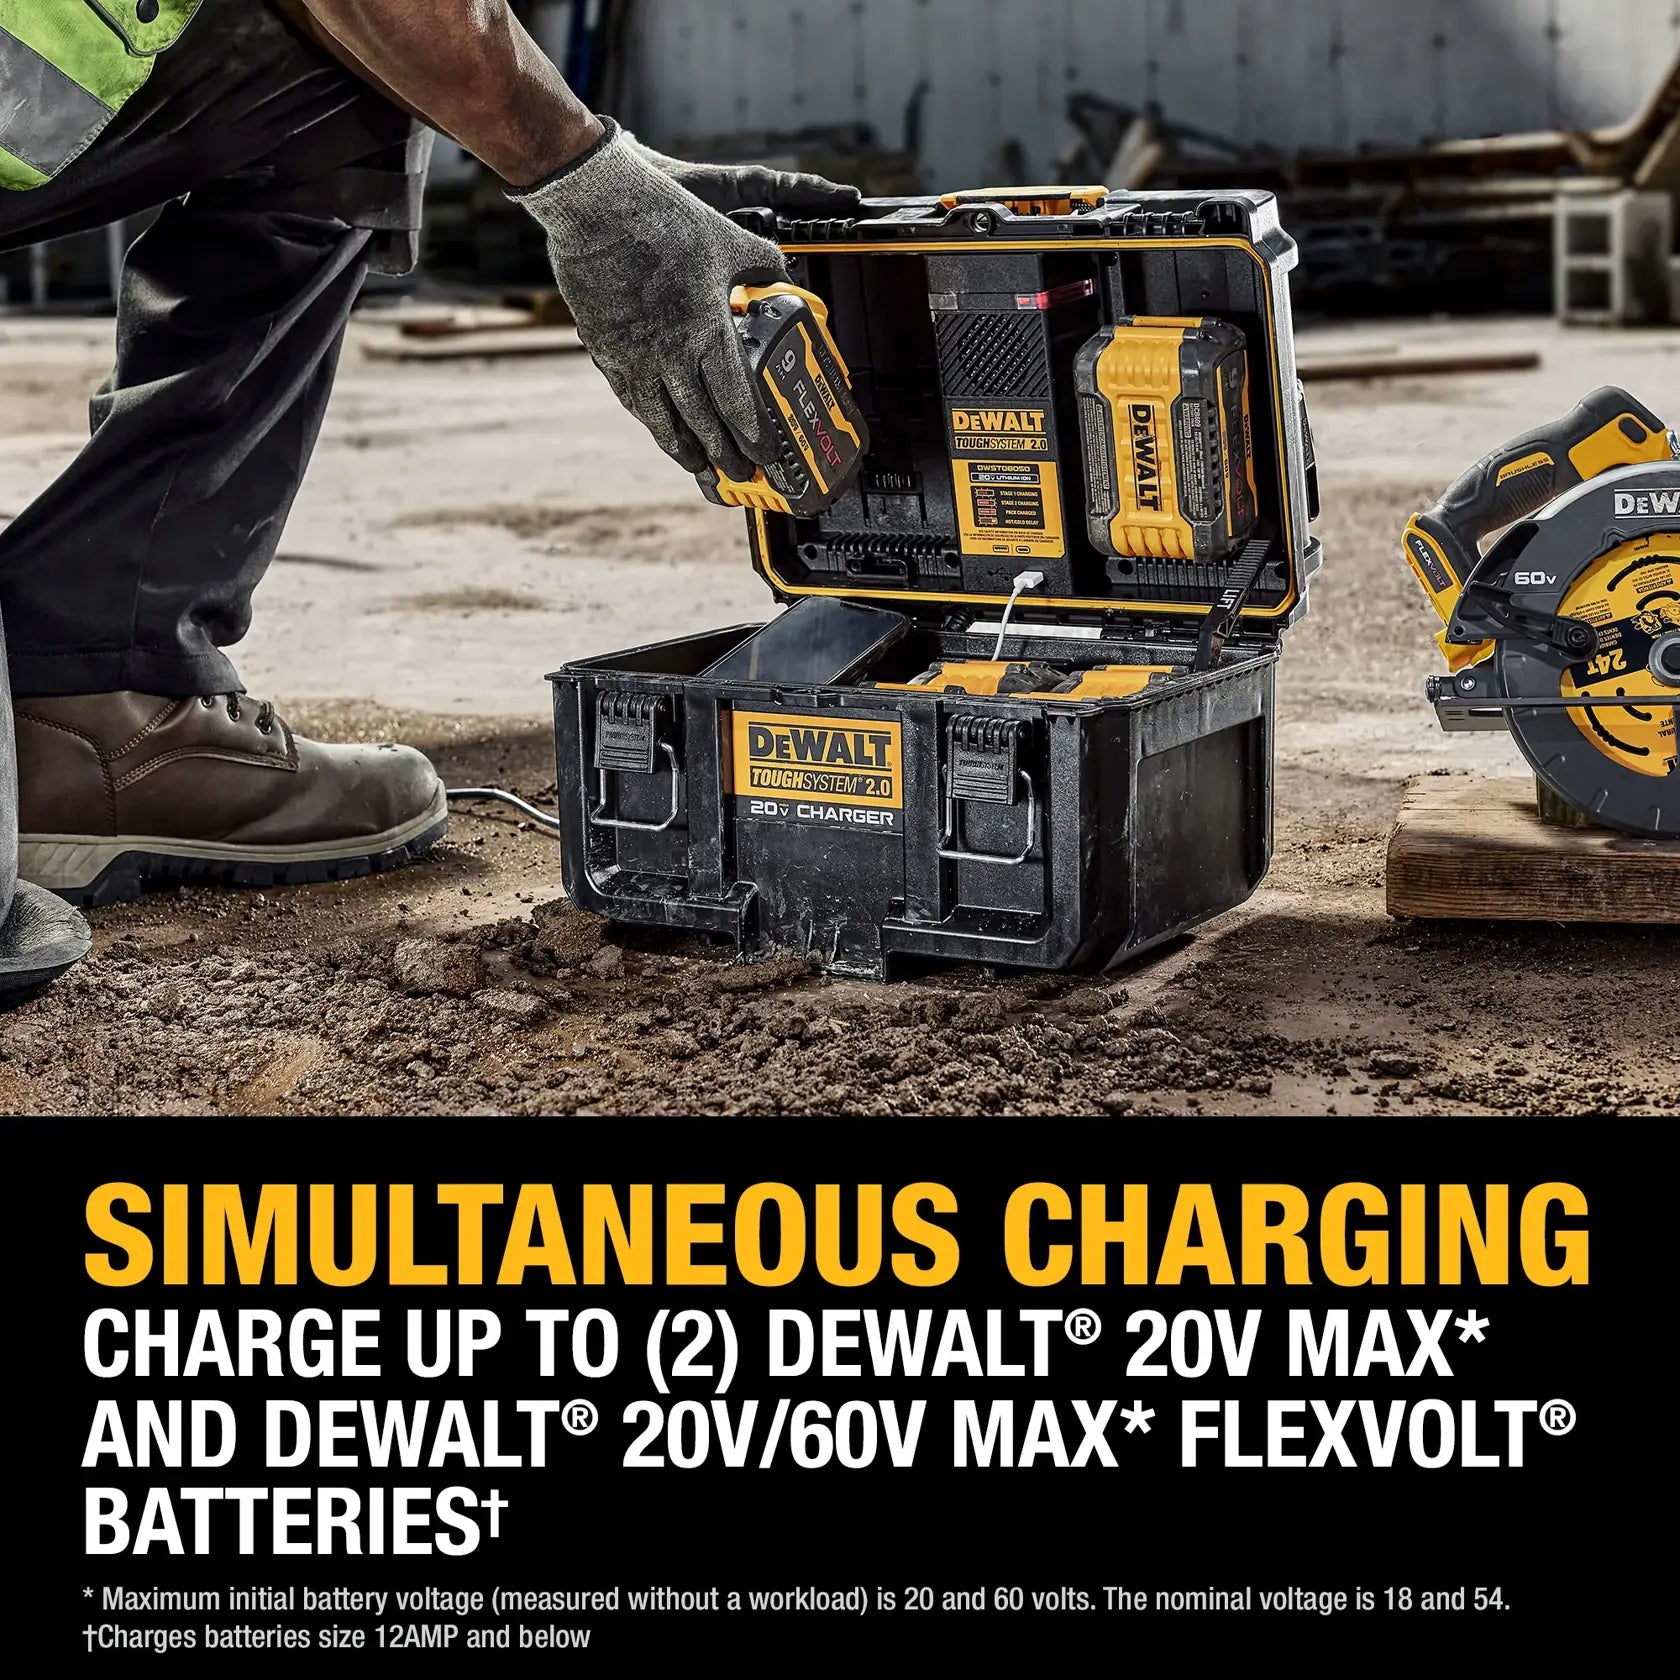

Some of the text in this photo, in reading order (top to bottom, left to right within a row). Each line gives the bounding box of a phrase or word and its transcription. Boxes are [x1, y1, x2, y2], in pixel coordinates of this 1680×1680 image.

[782, 349, 797, 373] 9
[792, 379, 843, 467] FLEXVOLT
[952, 411, 1045, 432] DEWALT
[956, 437, 1047, 450] TOUGHSYSTEM 2.0
[1131, 404, 1161, 512] DEWALT
[1499, 457, 1549, 479] BRUSHLESS
[1614, 492, 1680, 514] DEW
[1415, 539, 1446, 586] FLEXVOLT
[1216, 589, 1240, 610] LIFT
[865, 778, 891, 796] 2.0
[797, 804, 894, 826] CHARGER
